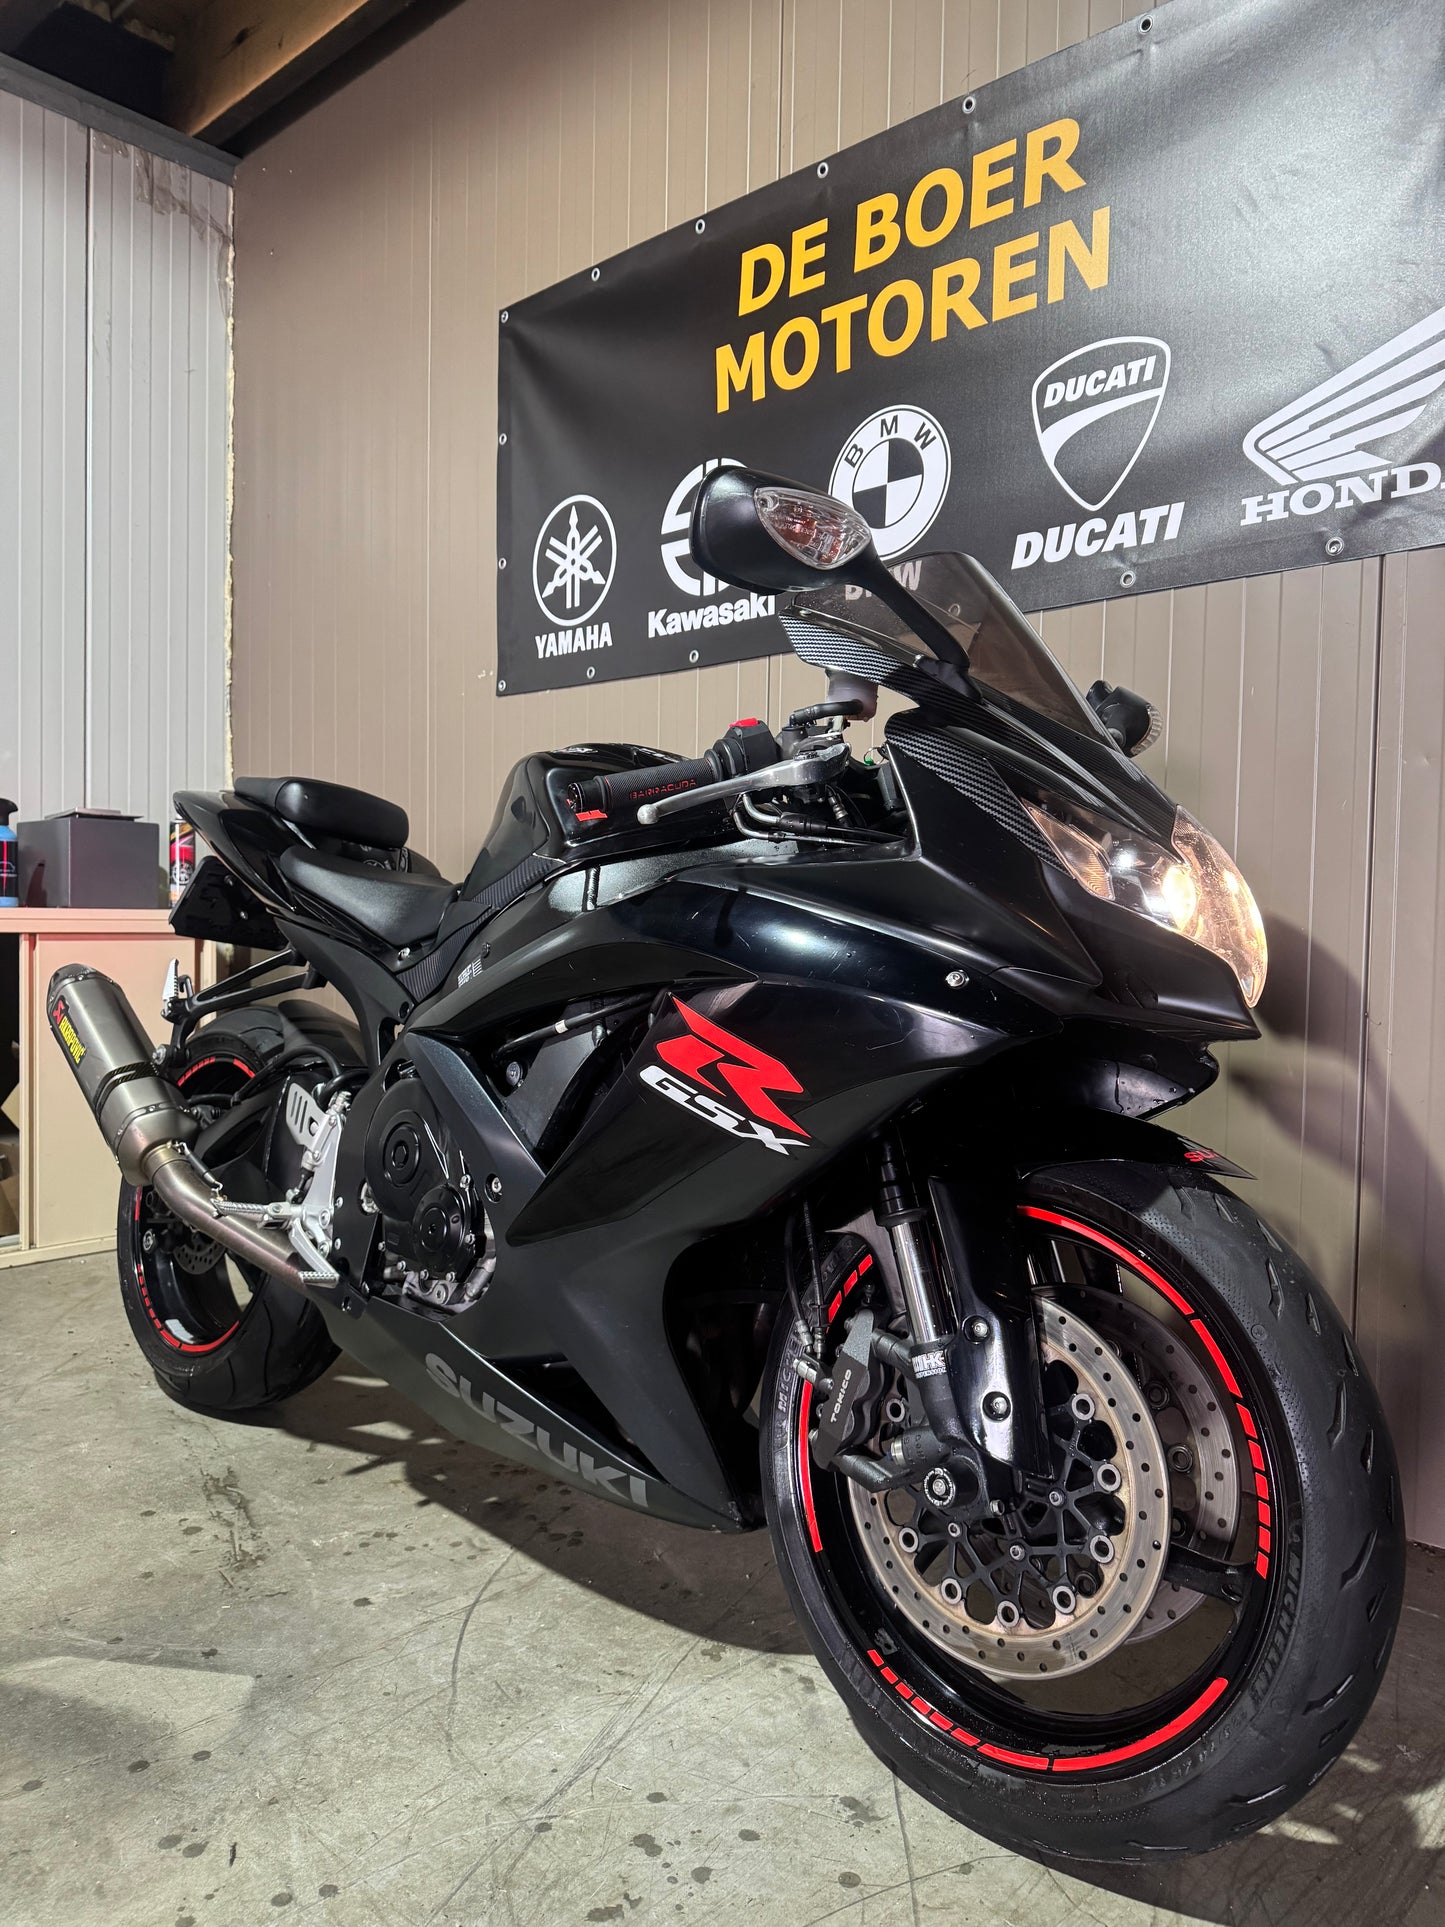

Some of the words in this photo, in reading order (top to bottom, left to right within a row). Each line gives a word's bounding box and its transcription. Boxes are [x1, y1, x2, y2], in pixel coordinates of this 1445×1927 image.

[738, 218, 828, 316] DE
[854, 118, 1087, 274] BOER
[715, 206, 1111, 413] MOTOREN
[1044, 355, 1156, 408] DUCATI
[844, 415, 937, 468] BMW
[1240, 462, 1445, 526] HOND
[1011, 501, 1185, 570] DUCATI
[535, 622, 613, 659] YAMAHA
[648, 592, 776, 638] Kawasaki
[629, 779, 697, 800] BARRACUDA
[639, 1065, 811, 1156] GSX
[830, 1368, 852, 1423] TOKICO
[425, 1352, 649, 1508] SUZUKI
